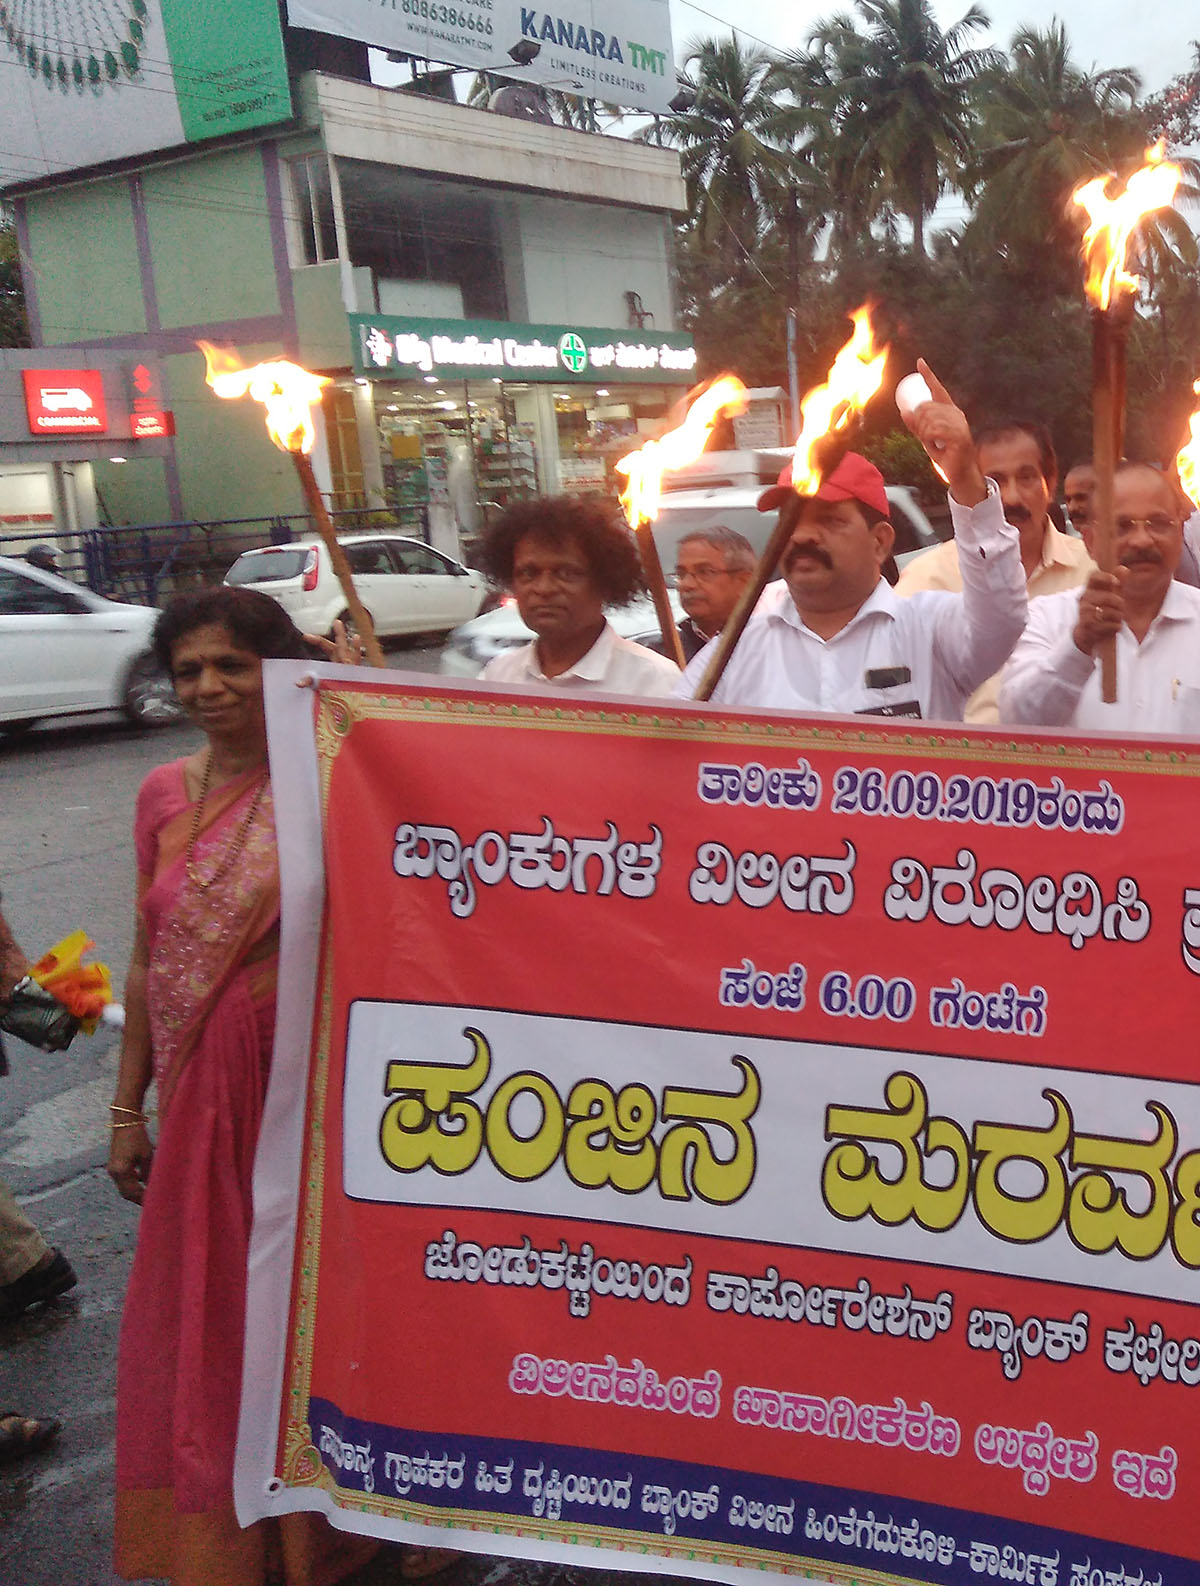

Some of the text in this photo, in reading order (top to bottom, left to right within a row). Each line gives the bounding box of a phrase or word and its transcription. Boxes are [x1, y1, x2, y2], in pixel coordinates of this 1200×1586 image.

[520, 7, 666, 76] KANARA TMT
[551, 58, 646, 93] LIMITLESS CREATIONS
[699, 758, 821, 811] ತಾರೀಕು
[393, 815, 663, 918] ಬ್ಯಾಂಕುಗಳ
[689, 838, 856, 915] ವಿಲೀನ
[884, 849, 1151, 950] ವಿರೋಧಿಸಿ
[719, 958, 1047, 1037] ಸಂಜೆ 6.00 ಗಂಟೆಗೆ
[379, 1026, 762, 1206] ಪಂಜಿನ
[967, 1310, 1089, 1380] ಬ್ಯಾಂಕ್
[384, 1449, 465, 1495] ಗ್ರಾಹಕರ
[474, 1457, 514, 1494] ಹಿತ
[641, 1484, 720, 1535] ಬ್ಯಾಂಕ್
[728, 1494, 795, 1535] ವಿಲೀನ
[975, 1421, 1099, 1496] ಉದ್ದೇಶ
[1112, 1446, 1178, 1500] ಇದೆ
